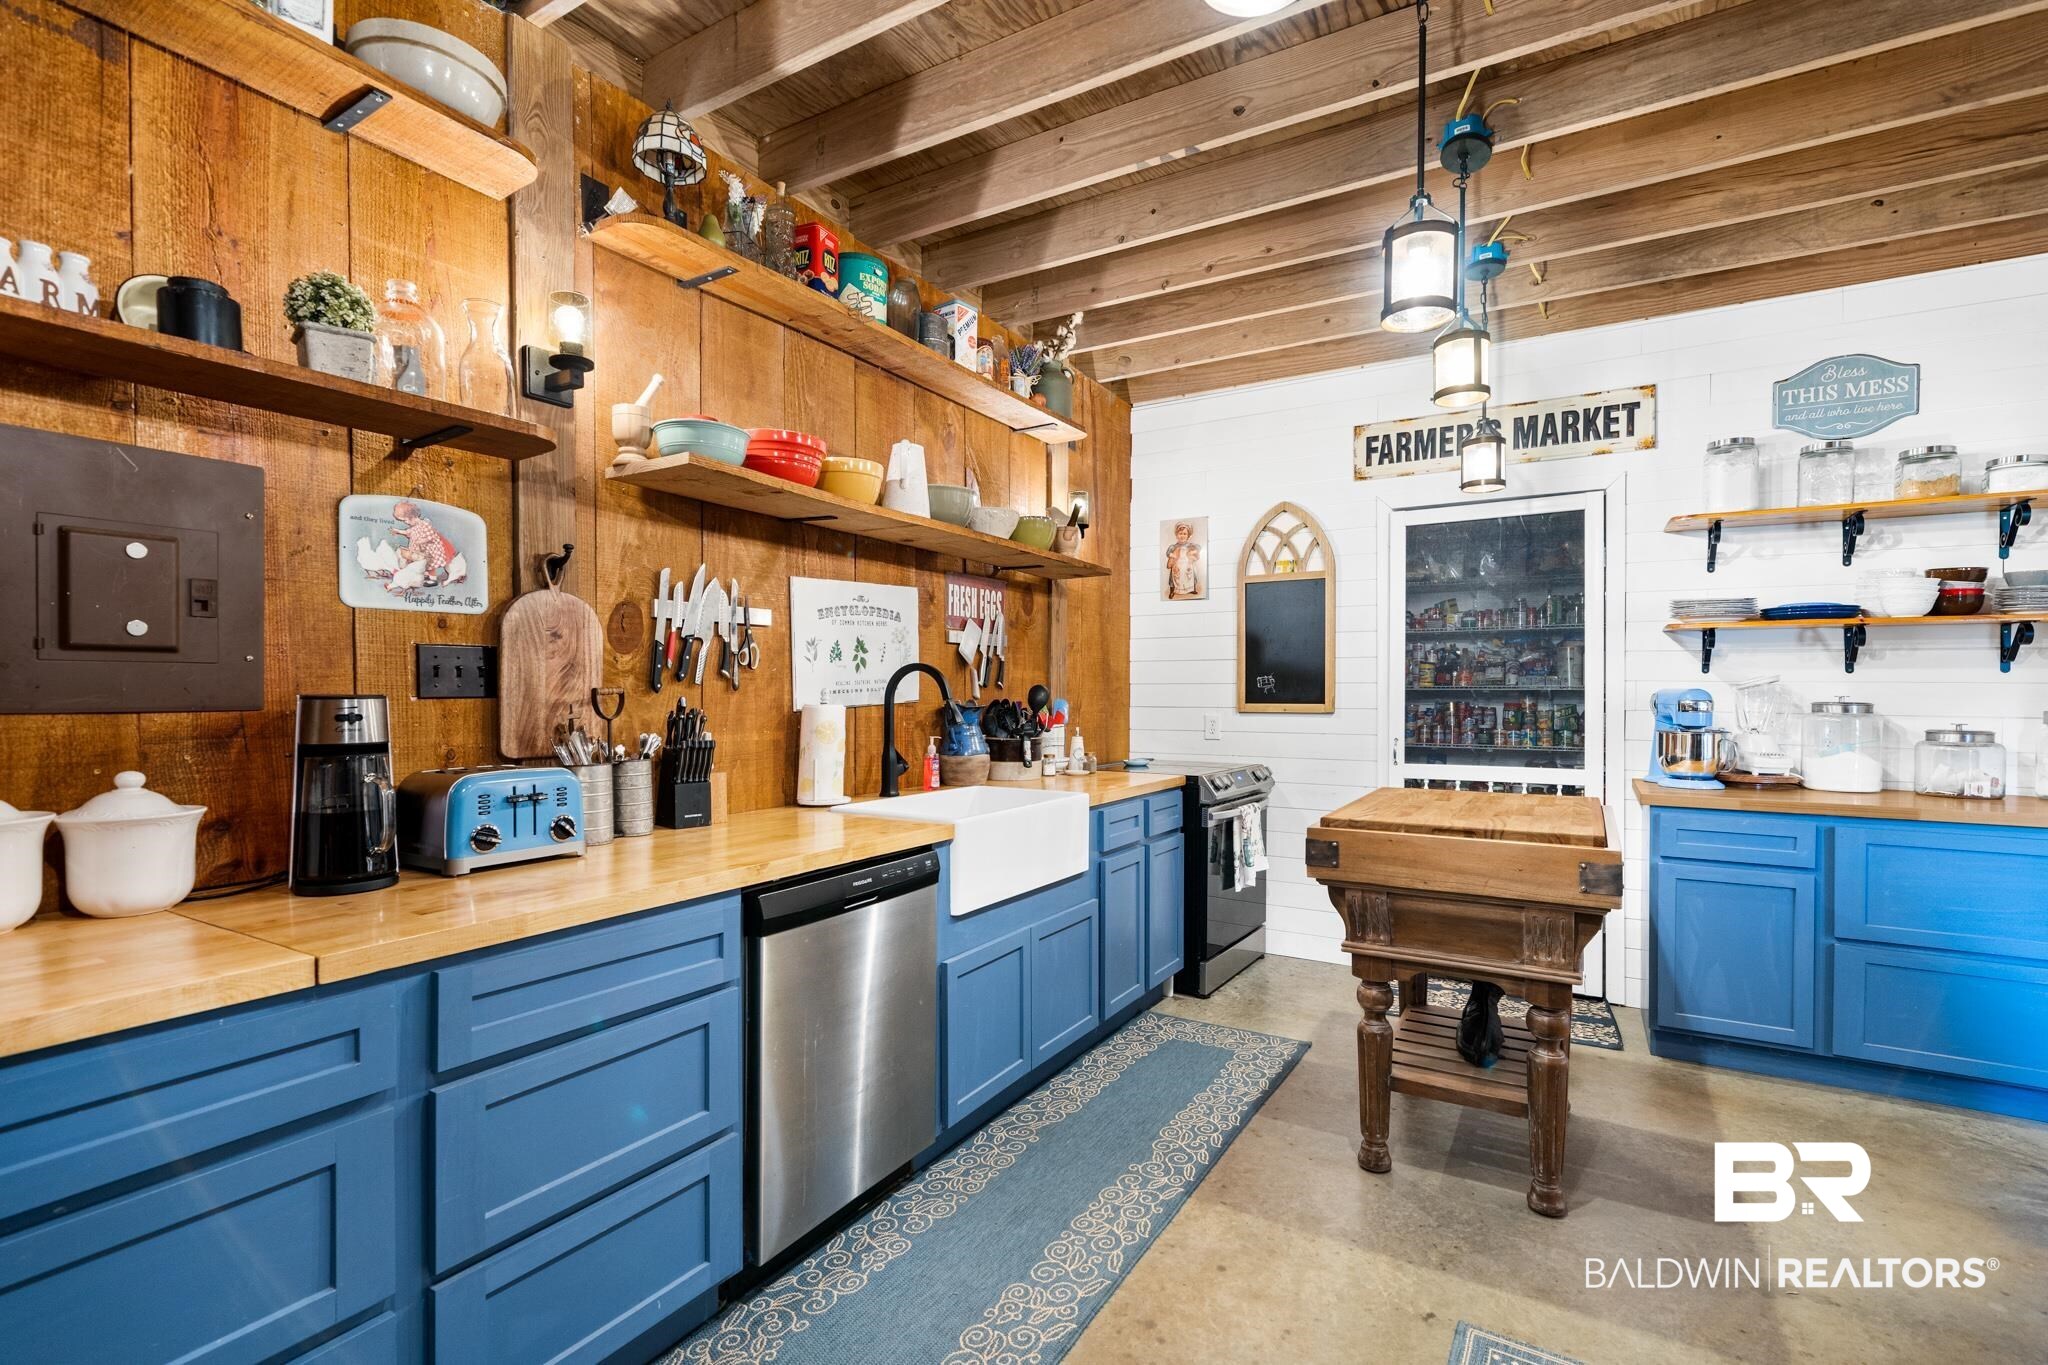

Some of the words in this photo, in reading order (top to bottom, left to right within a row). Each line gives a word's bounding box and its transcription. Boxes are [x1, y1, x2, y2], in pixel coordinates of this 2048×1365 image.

[823, 252, 836, 273] RITZ
[957, 313, 977, 337] PREMIUM
[1821, 364, 1867, 383] Bless
[1782, 384, 1838, 406] THIS
[1844, 375, 1909, 399] MESS
[1784, 411, 1808, 422] and
[1809, 408, 1826, 419] all
[1827, 406, 1851, 417] who
[1853, 404, 1875, 415] live
[1365, 419, 1502, 467] FARMER
[1513, 401, 1641, 450] MARKET
[404, 592, 435, 607] Happily
[948, 583, 978, 619] FRESH
[980, 588, 1002, 621] EGGS
[817, 605, 902, 623] ENCYCLOPEDIA
[852, 877, 873, 887] FRIGIDAIRE
